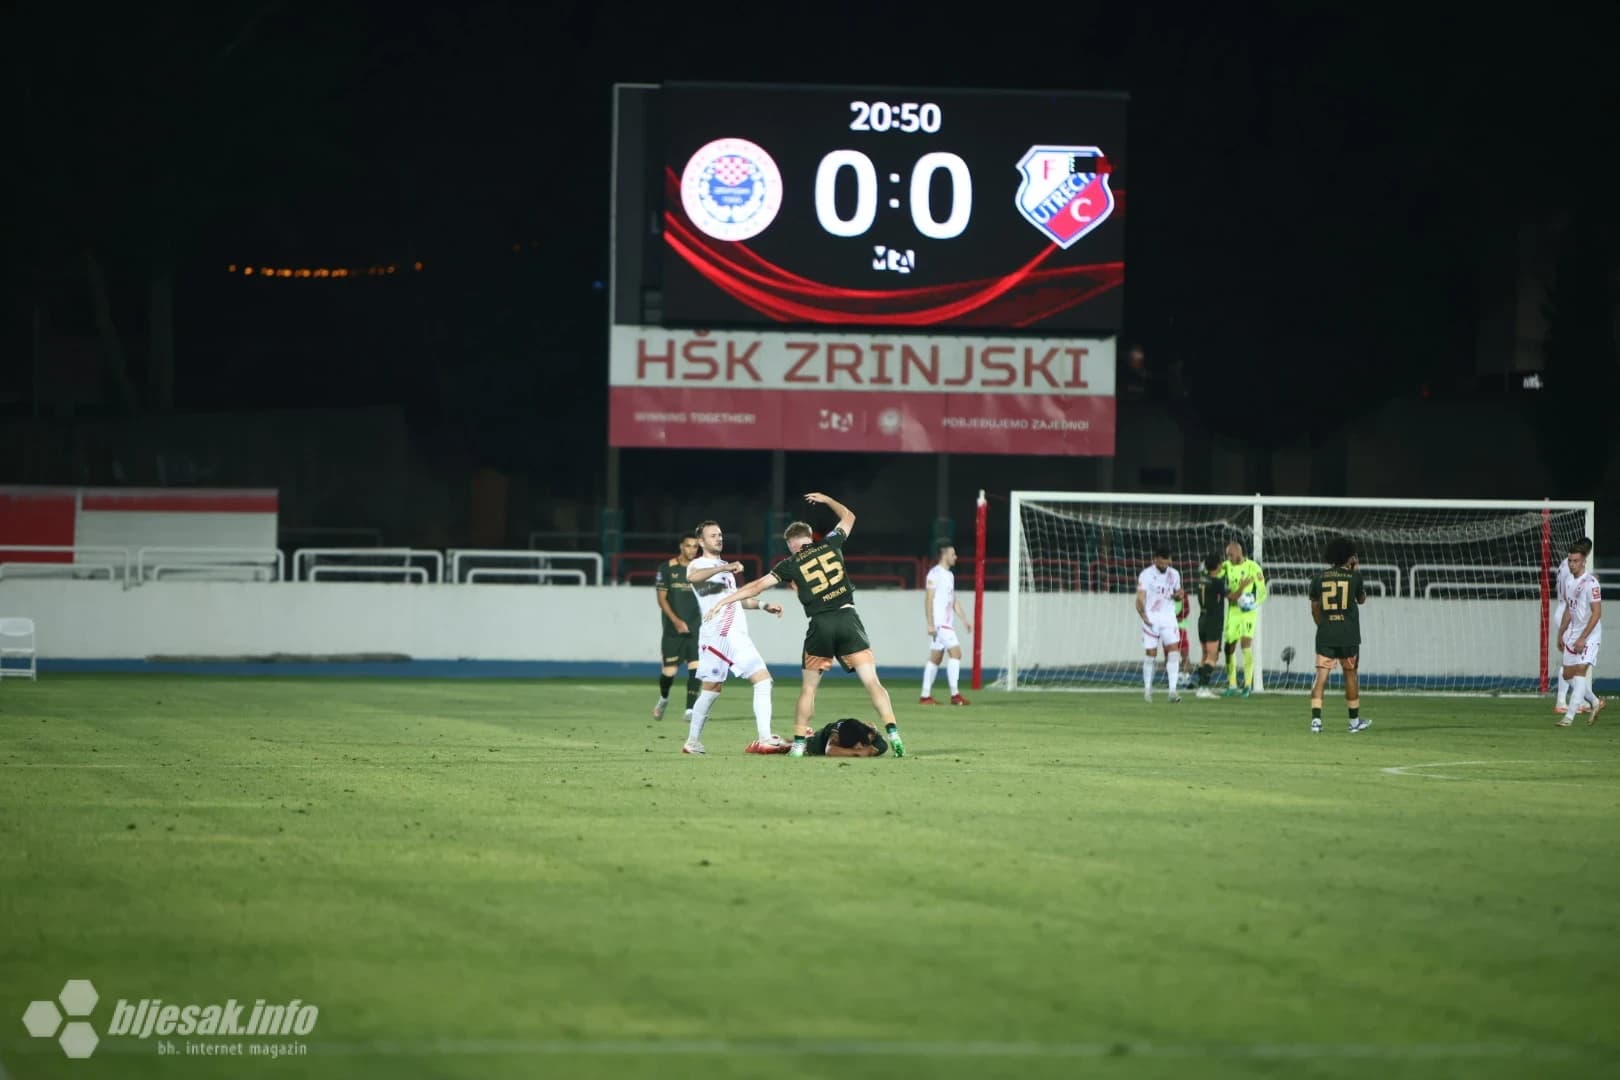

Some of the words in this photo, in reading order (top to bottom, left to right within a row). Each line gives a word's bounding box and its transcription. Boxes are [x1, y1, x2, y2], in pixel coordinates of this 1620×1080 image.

[849, 100, 942, 133] 20:50
[1043, 159, 1057, 180] F
[1069, 197, 1093, 223] C
[635, 329, 763, 382] HŠK
[783, 341, 1090, 389] ZRINJSKI
[634, 412, 687, 424] WINNING
[690, 411, 756, 425] TOGETHER!
[1032, 419, 1089, 432] ZAJEDNO!
[799, 550, 844, 596] 55
[1321, 580, 1349, 610] 27
